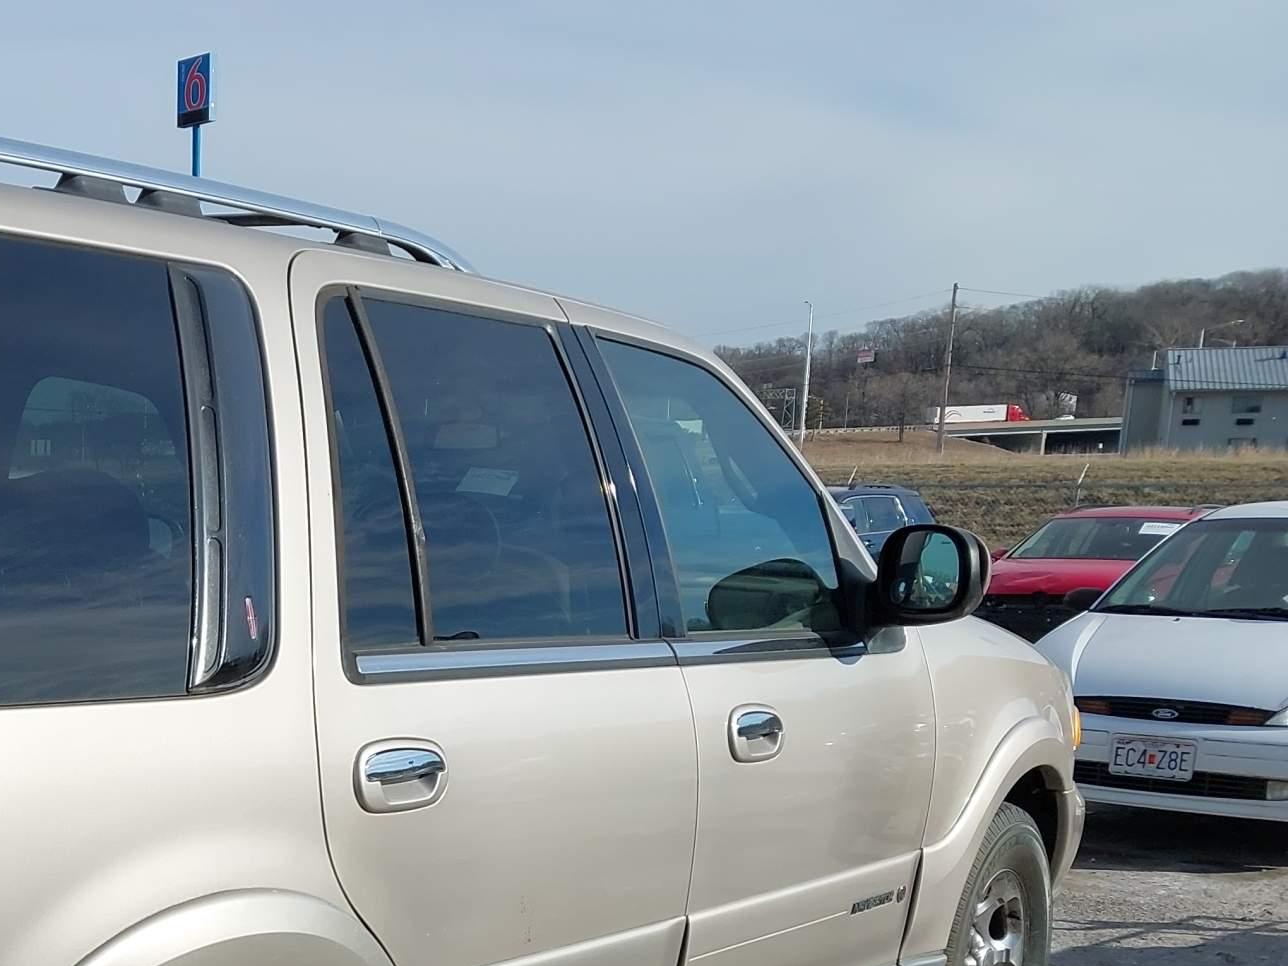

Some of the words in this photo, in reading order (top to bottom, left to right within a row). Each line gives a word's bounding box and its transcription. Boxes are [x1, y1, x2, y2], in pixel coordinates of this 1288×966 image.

[184, 57, 207, 112] 6
[1113, 746, 1147, 768] EC4
[1156, 750, 1191, 772] Z8E
